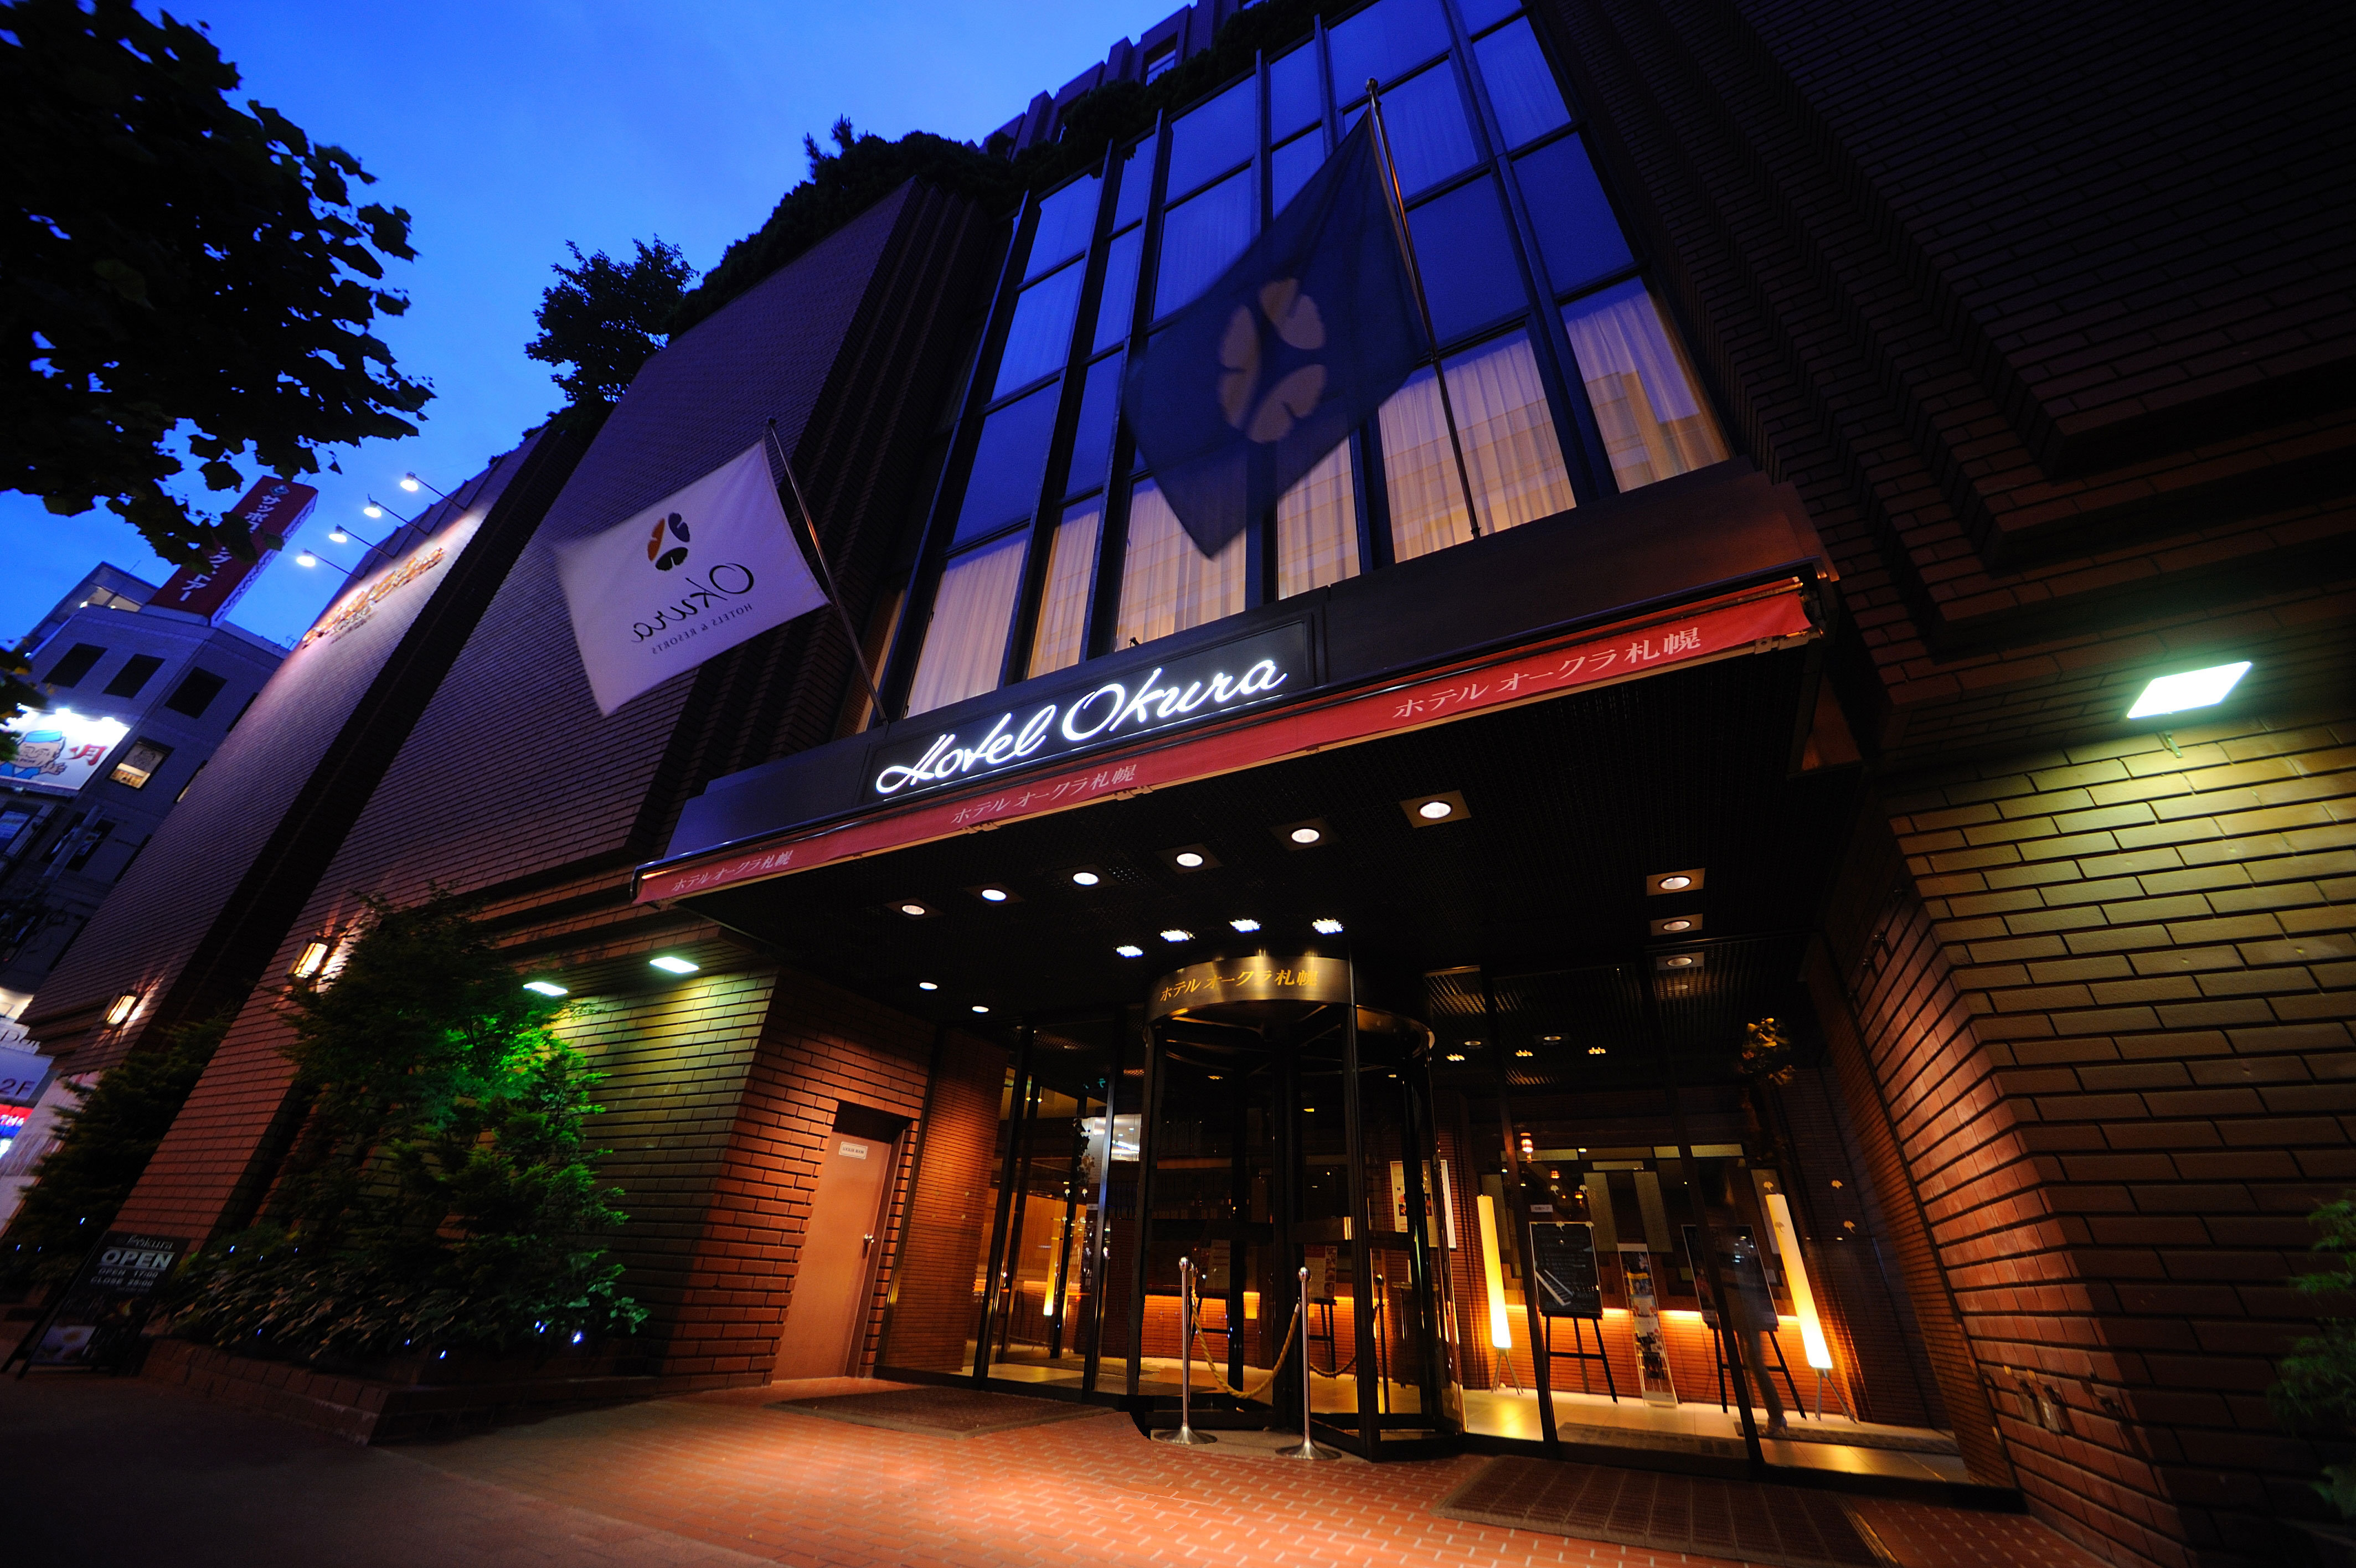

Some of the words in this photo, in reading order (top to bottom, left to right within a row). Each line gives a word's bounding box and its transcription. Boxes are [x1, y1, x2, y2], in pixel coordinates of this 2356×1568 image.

[875, 704, 1057, 794] Hotel
[1061, 659, 1288, 741] Okura
[101, 1249, 174, 1270] OPEN
